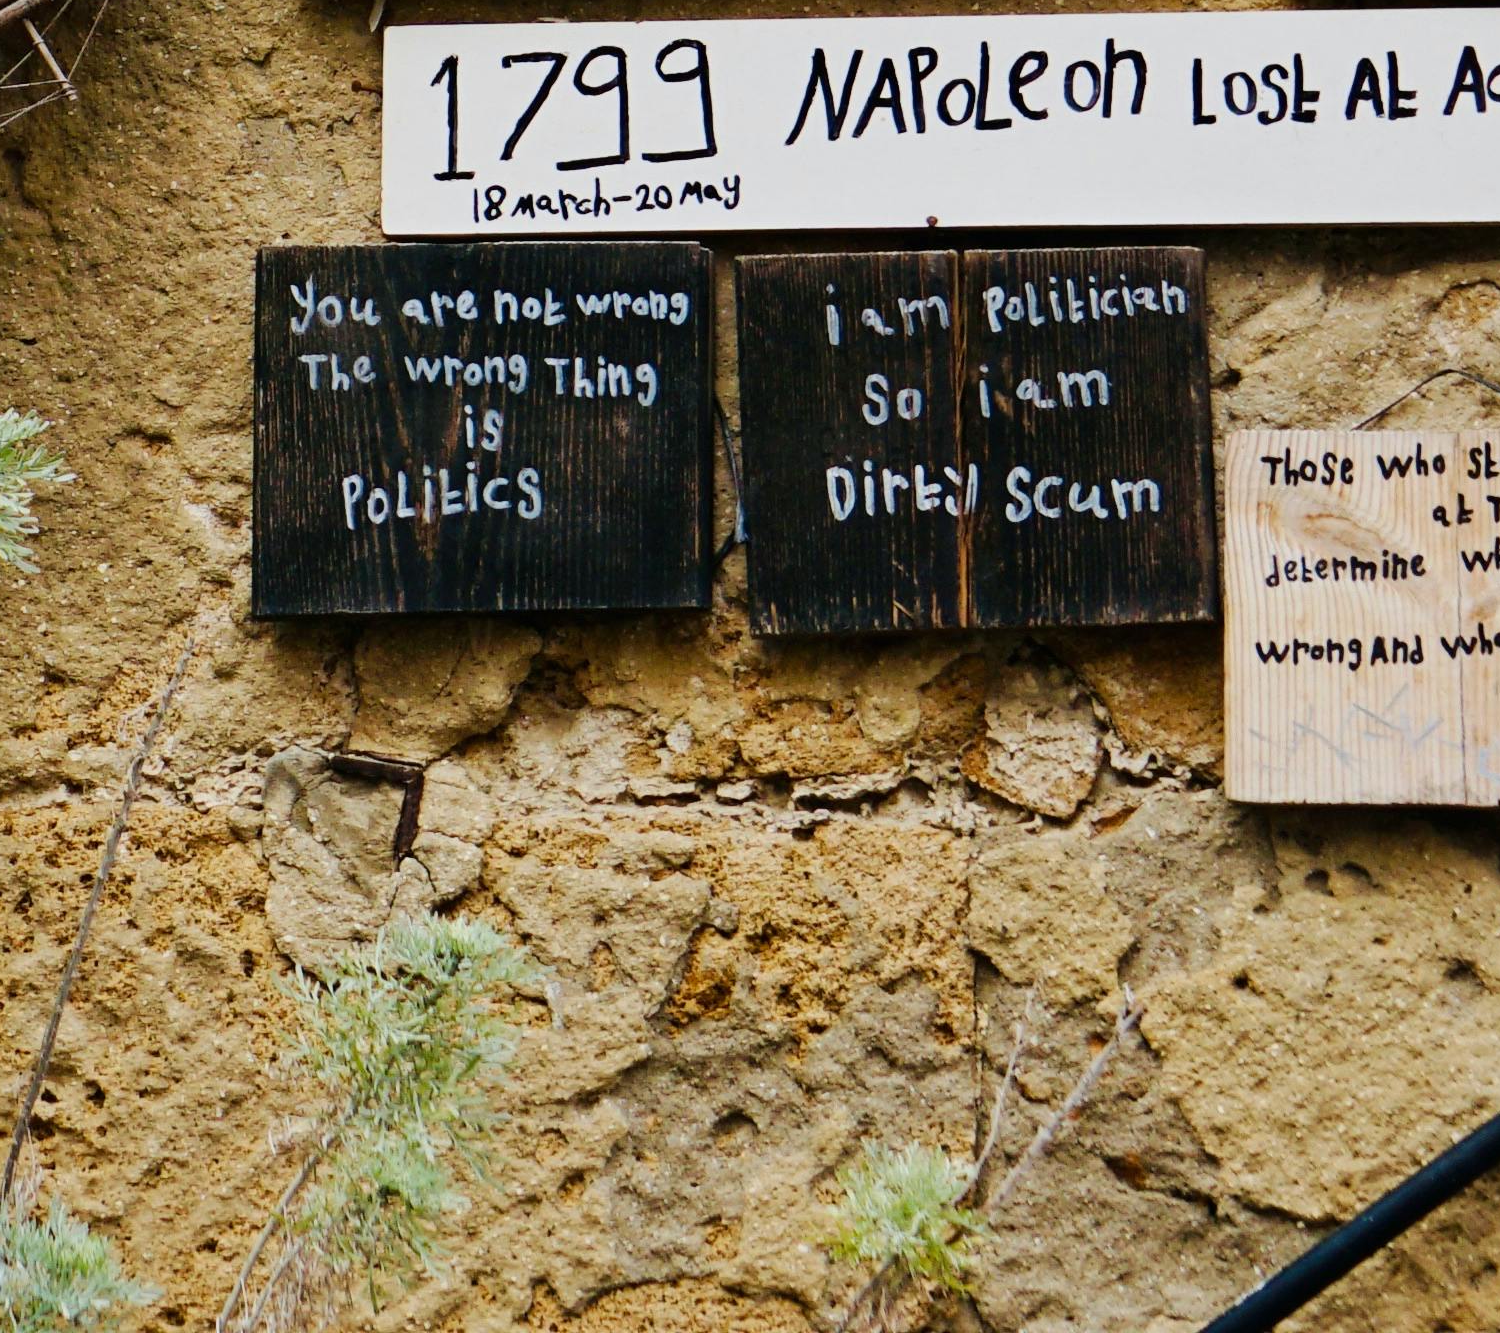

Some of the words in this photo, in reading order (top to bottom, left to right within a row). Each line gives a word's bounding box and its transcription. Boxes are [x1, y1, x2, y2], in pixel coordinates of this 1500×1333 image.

[432, 38, 717, 183] 1799
[402, 290, 478, 327] are
[494, 287, 567, 326] not
[299, 354, 376, 391] The
[464, 404, 502, 451] is
